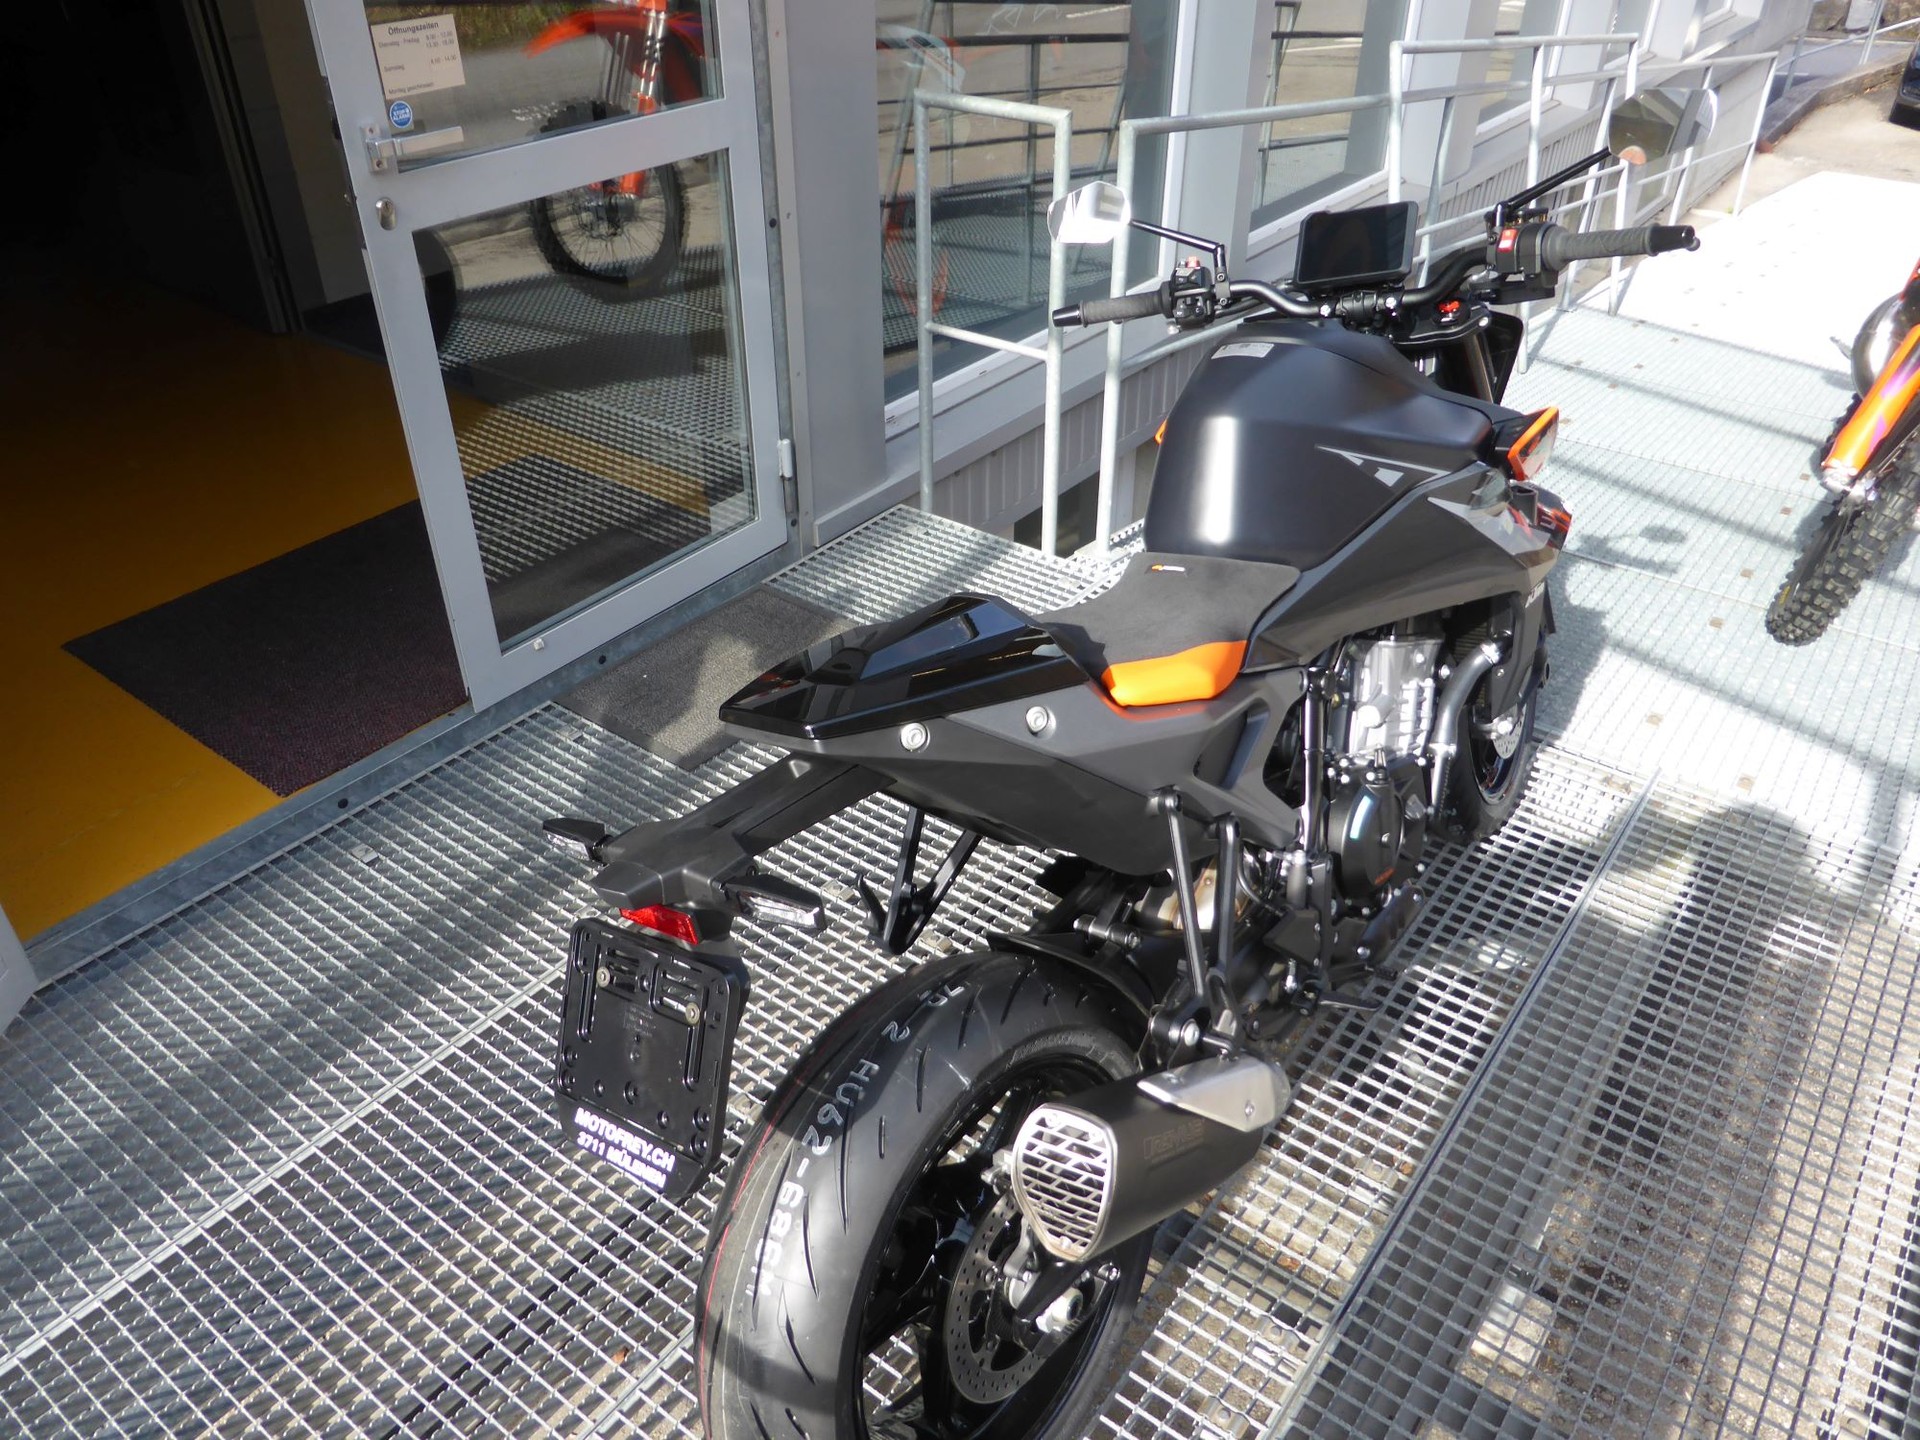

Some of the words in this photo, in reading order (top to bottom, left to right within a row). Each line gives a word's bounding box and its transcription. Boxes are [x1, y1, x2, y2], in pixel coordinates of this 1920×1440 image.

[388, 22, 439, 35] Öffnungszeiten
[574, 1106, 676, 1172] MOTOFREY.CH
[577, 1131, 606, 1156] 3711
